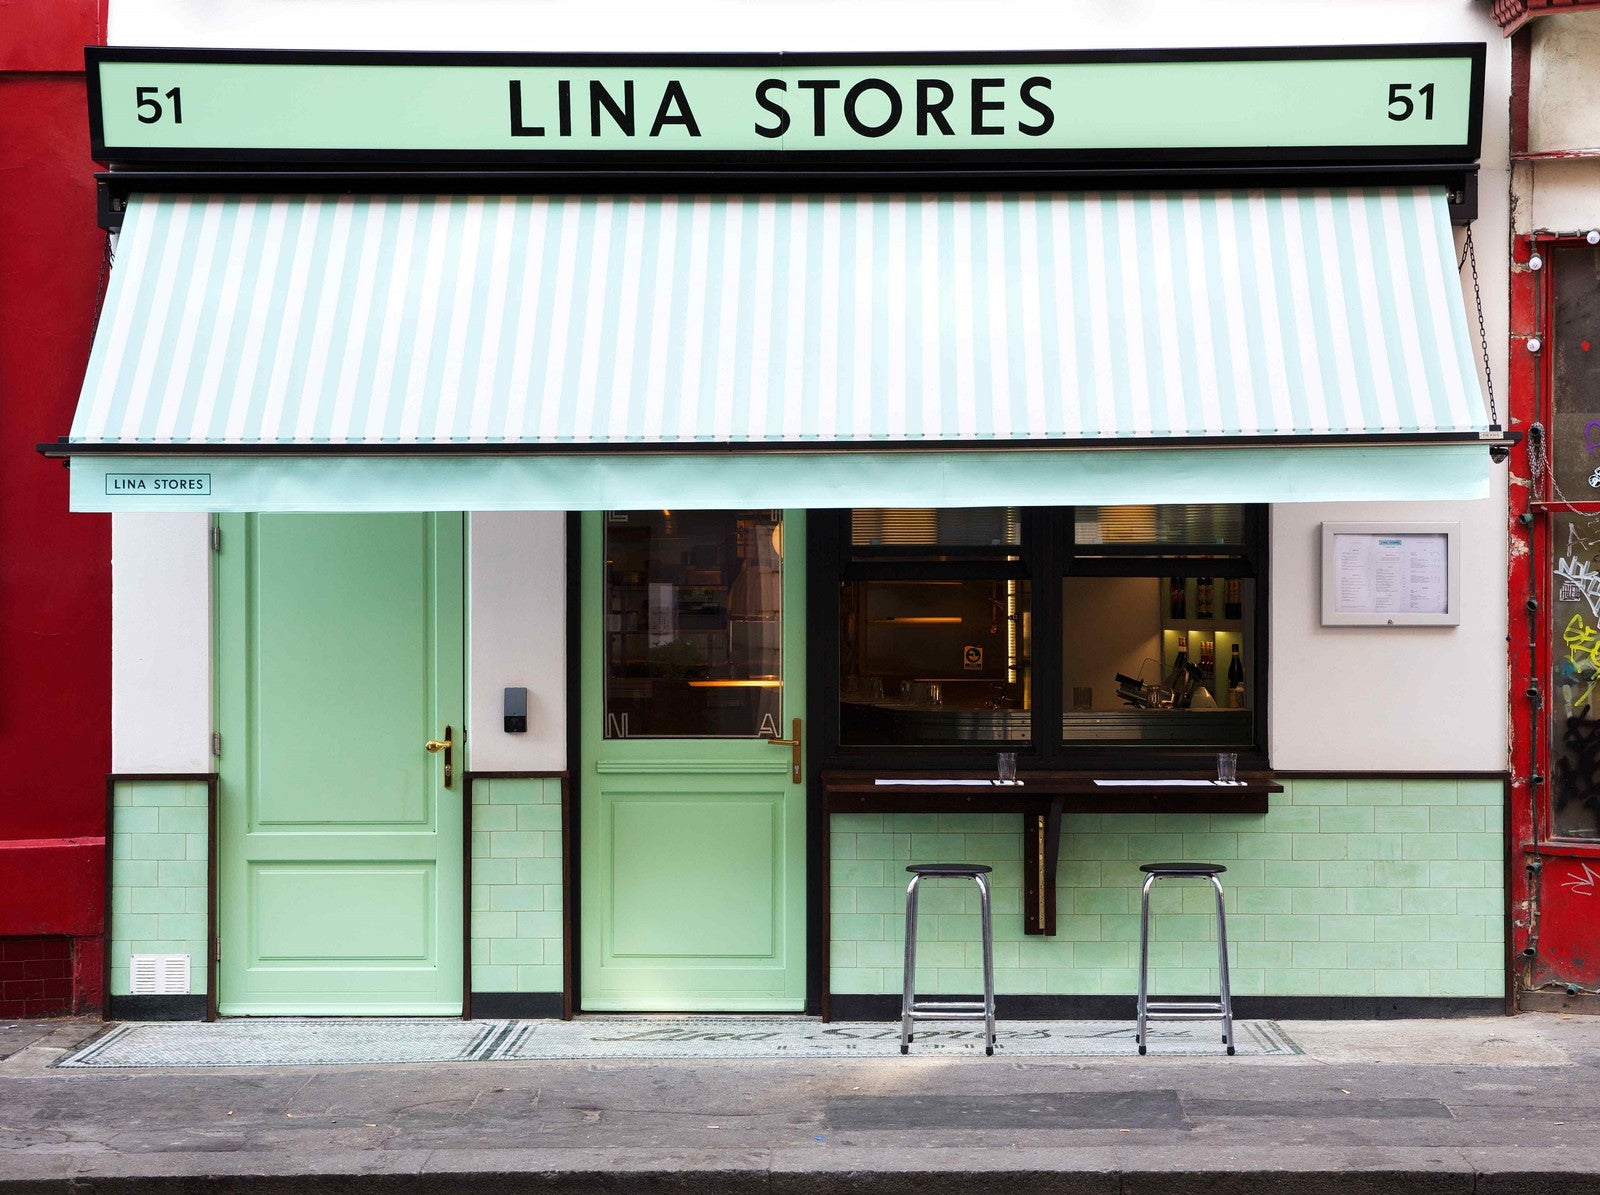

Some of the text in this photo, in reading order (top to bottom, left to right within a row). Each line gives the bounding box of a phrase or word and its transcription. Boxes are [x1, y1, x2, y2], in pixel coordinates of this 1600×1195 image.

[136, 86, 183, 125] 51
[509, 76, 1055, 139] LINA STORES
[1387, 82, 1435, 122] 51
[114, 479, 204, 490] LINA STORES
[590, 1028, 780, 1041] Lina
